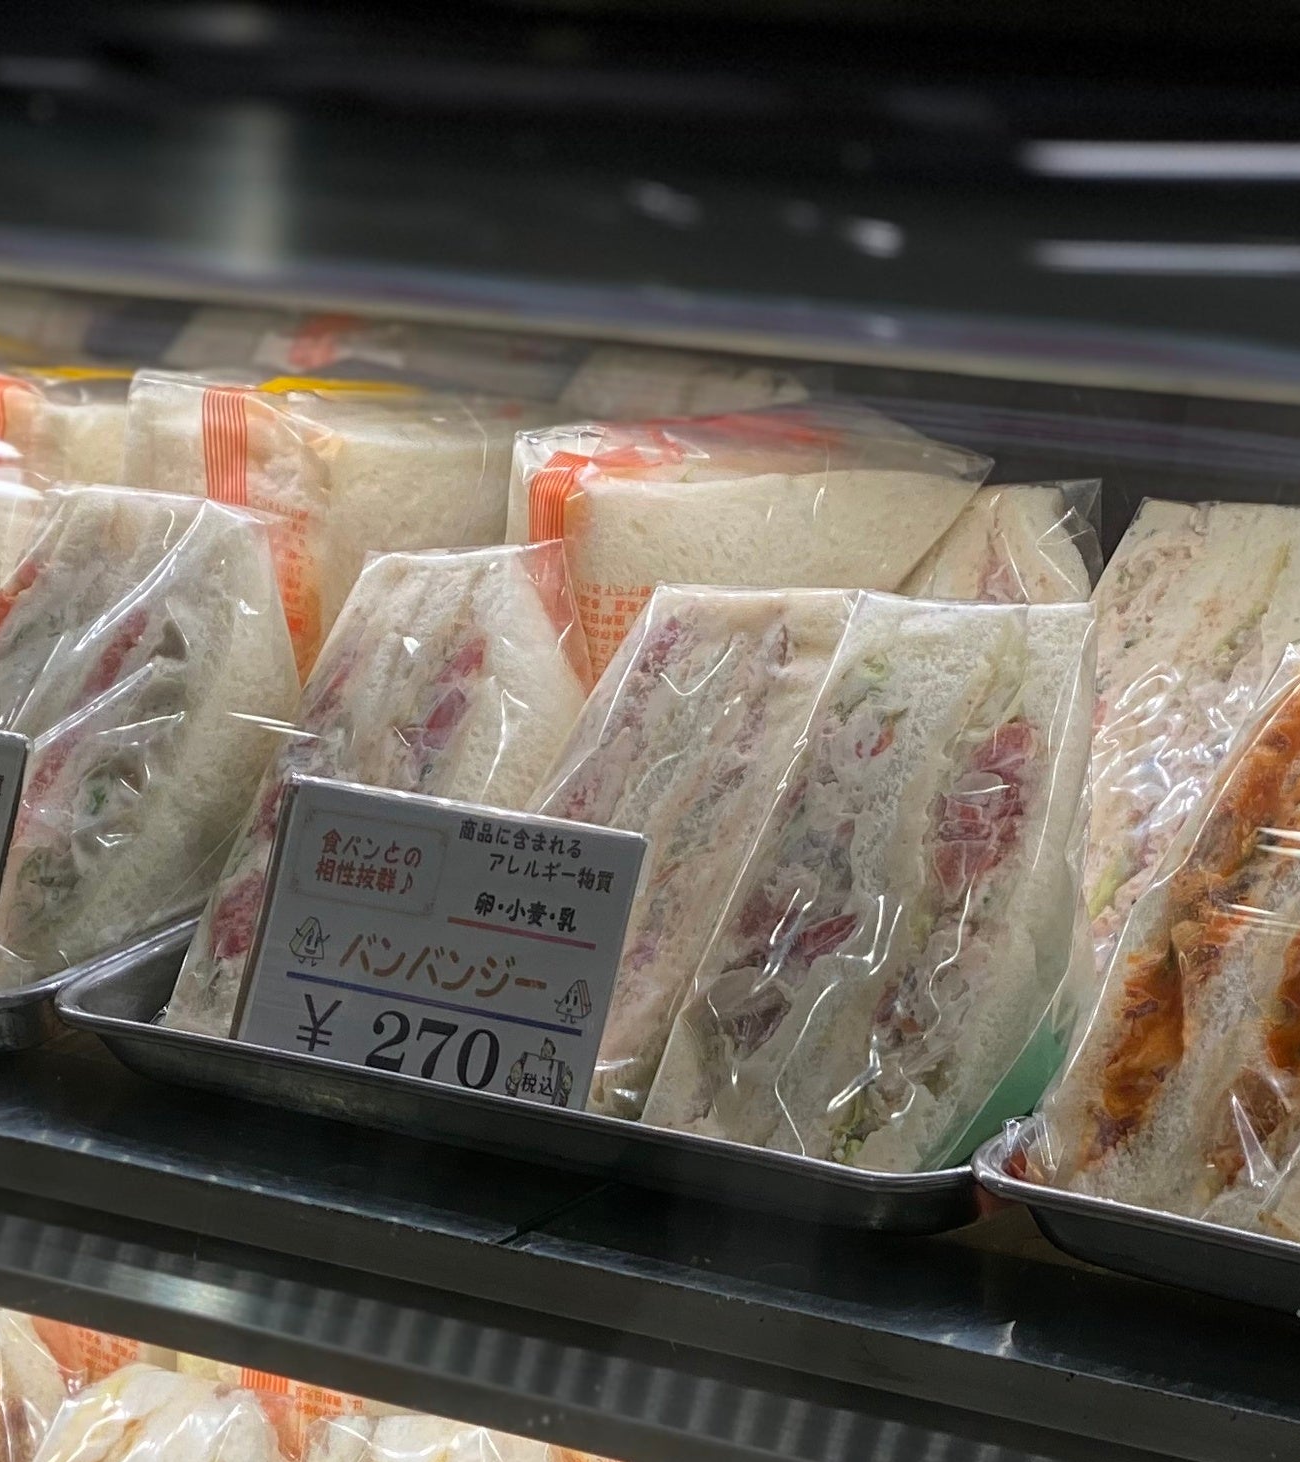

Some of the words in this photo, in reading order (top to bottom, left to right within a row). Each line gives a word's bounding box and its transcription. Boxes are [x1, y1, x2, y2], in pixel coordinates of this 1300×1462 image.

[321, 828, 423, 868] 食パンとの
[459, 818, 582, 858] 商品に含まれる
[488, 852, 614, 894] アレルギー物質
[474, 892, 577, 934] 卵・小麦・乳
[338, 932, 548, 998] バンバンジー
[522, 1072, 553, 1096] 税込
